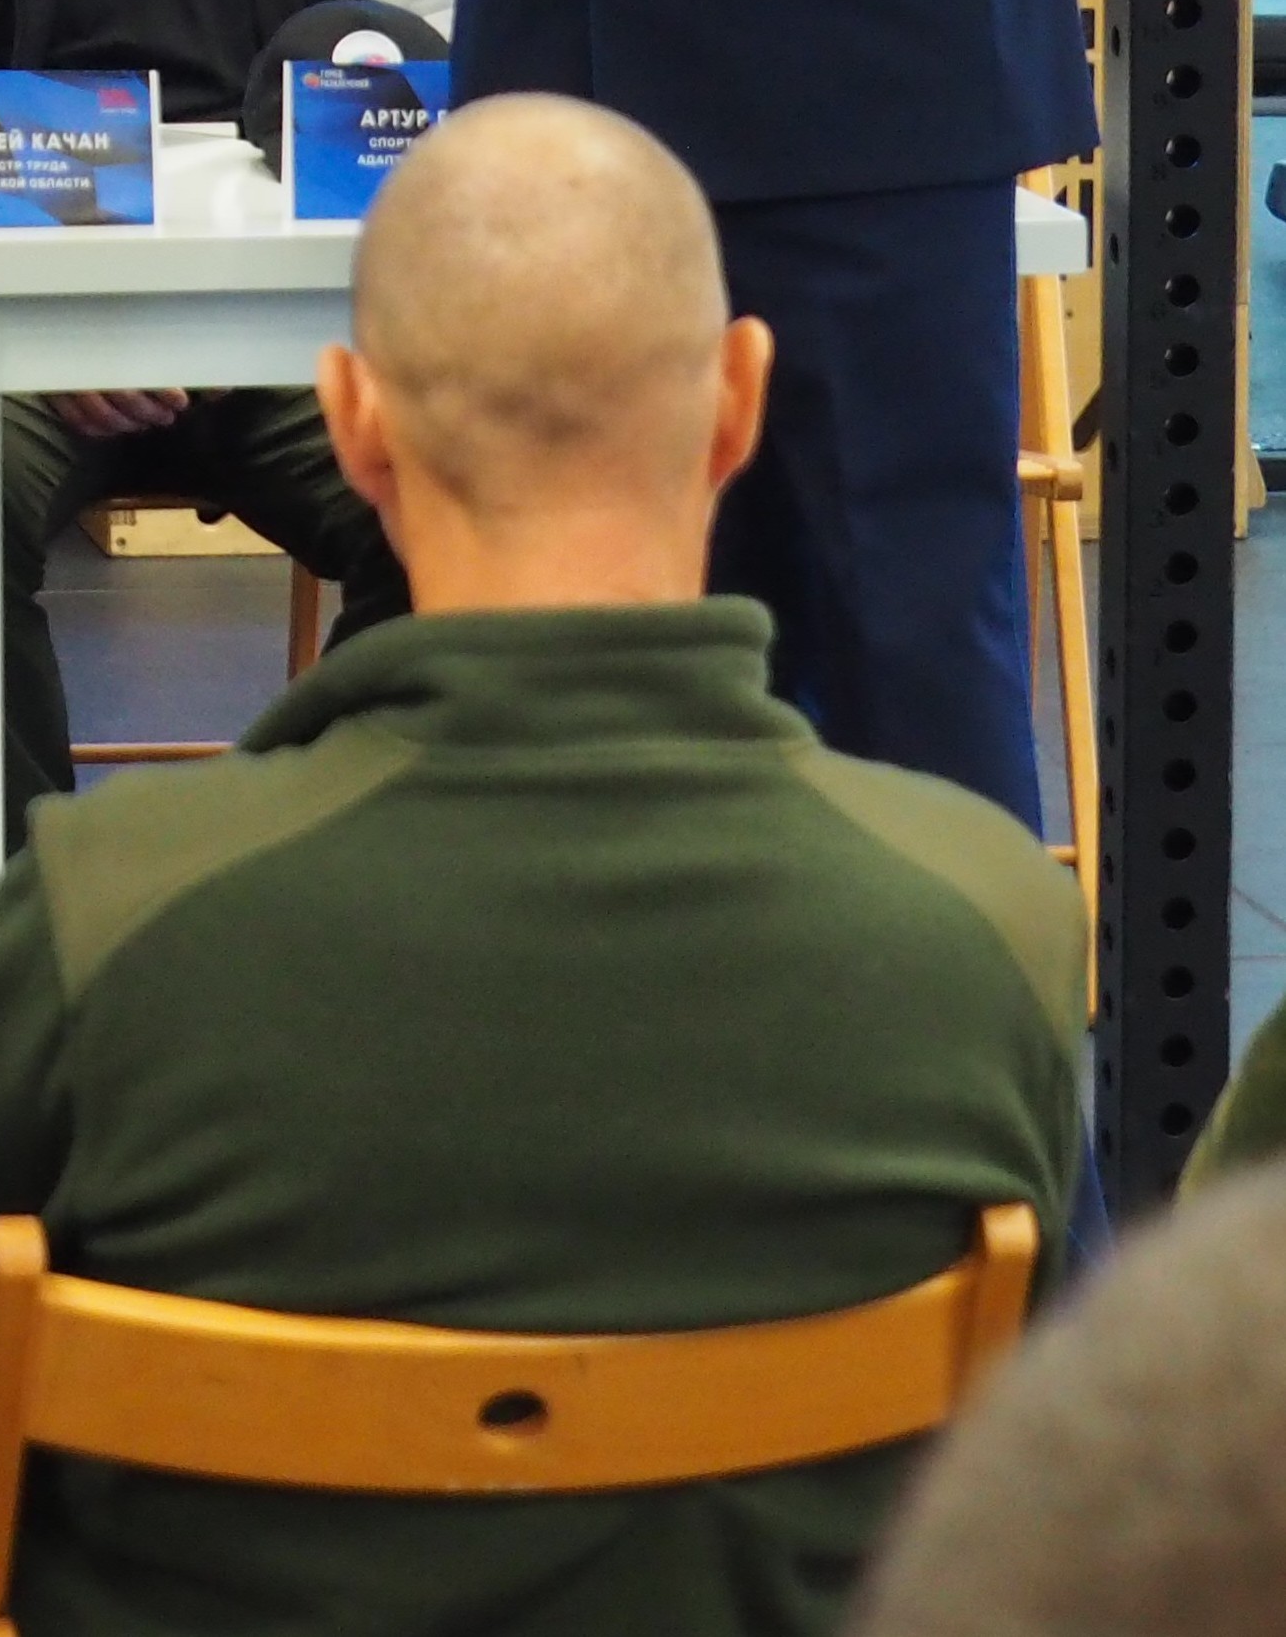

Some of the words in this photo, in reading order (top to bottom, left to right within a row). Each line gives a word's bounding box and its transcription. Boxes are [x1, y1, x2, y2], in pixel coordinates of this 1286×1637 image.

[360, 109, 428, 128] АРТУР
[31, 131, 111, 150] КАЧАН
[26, 159, 69, 172] ТРУДА
[29, 176, 91, 189] ОБЛАСТИ
